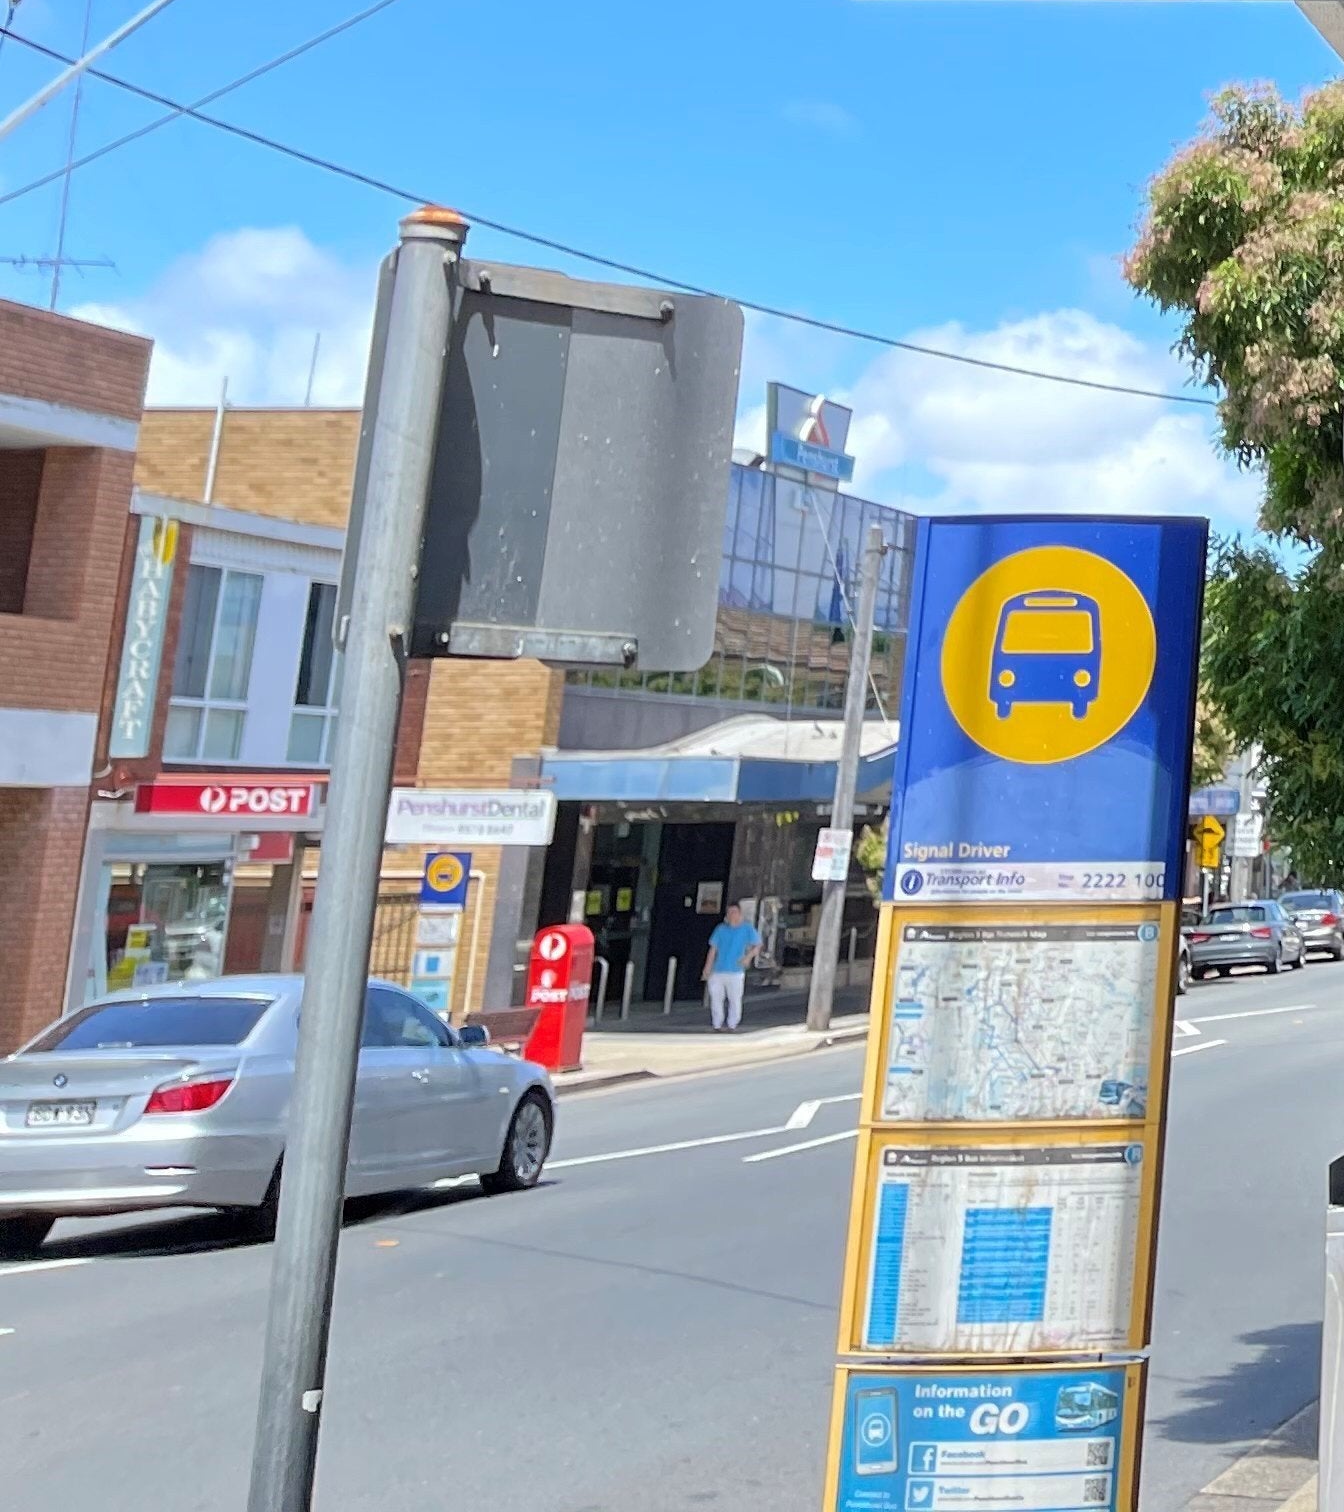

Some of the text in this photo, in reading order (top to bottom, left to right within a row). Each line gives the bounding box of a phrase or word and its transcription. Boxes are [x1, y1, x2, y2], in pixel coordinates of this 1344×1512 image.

[229, 788, 306, 813] POST
[903, 841, 1011, 863] Signal Driver
[926, 872, 993, 888] Transport
[995, 871, 1026, 886] Info
[1081, 873, 1127, 888] 2222
[915, 1382, 1013, 1399] Information
[913, 1401, 1031, 1436] on the GO
[941, 1449, 986, 1459] Facebook
